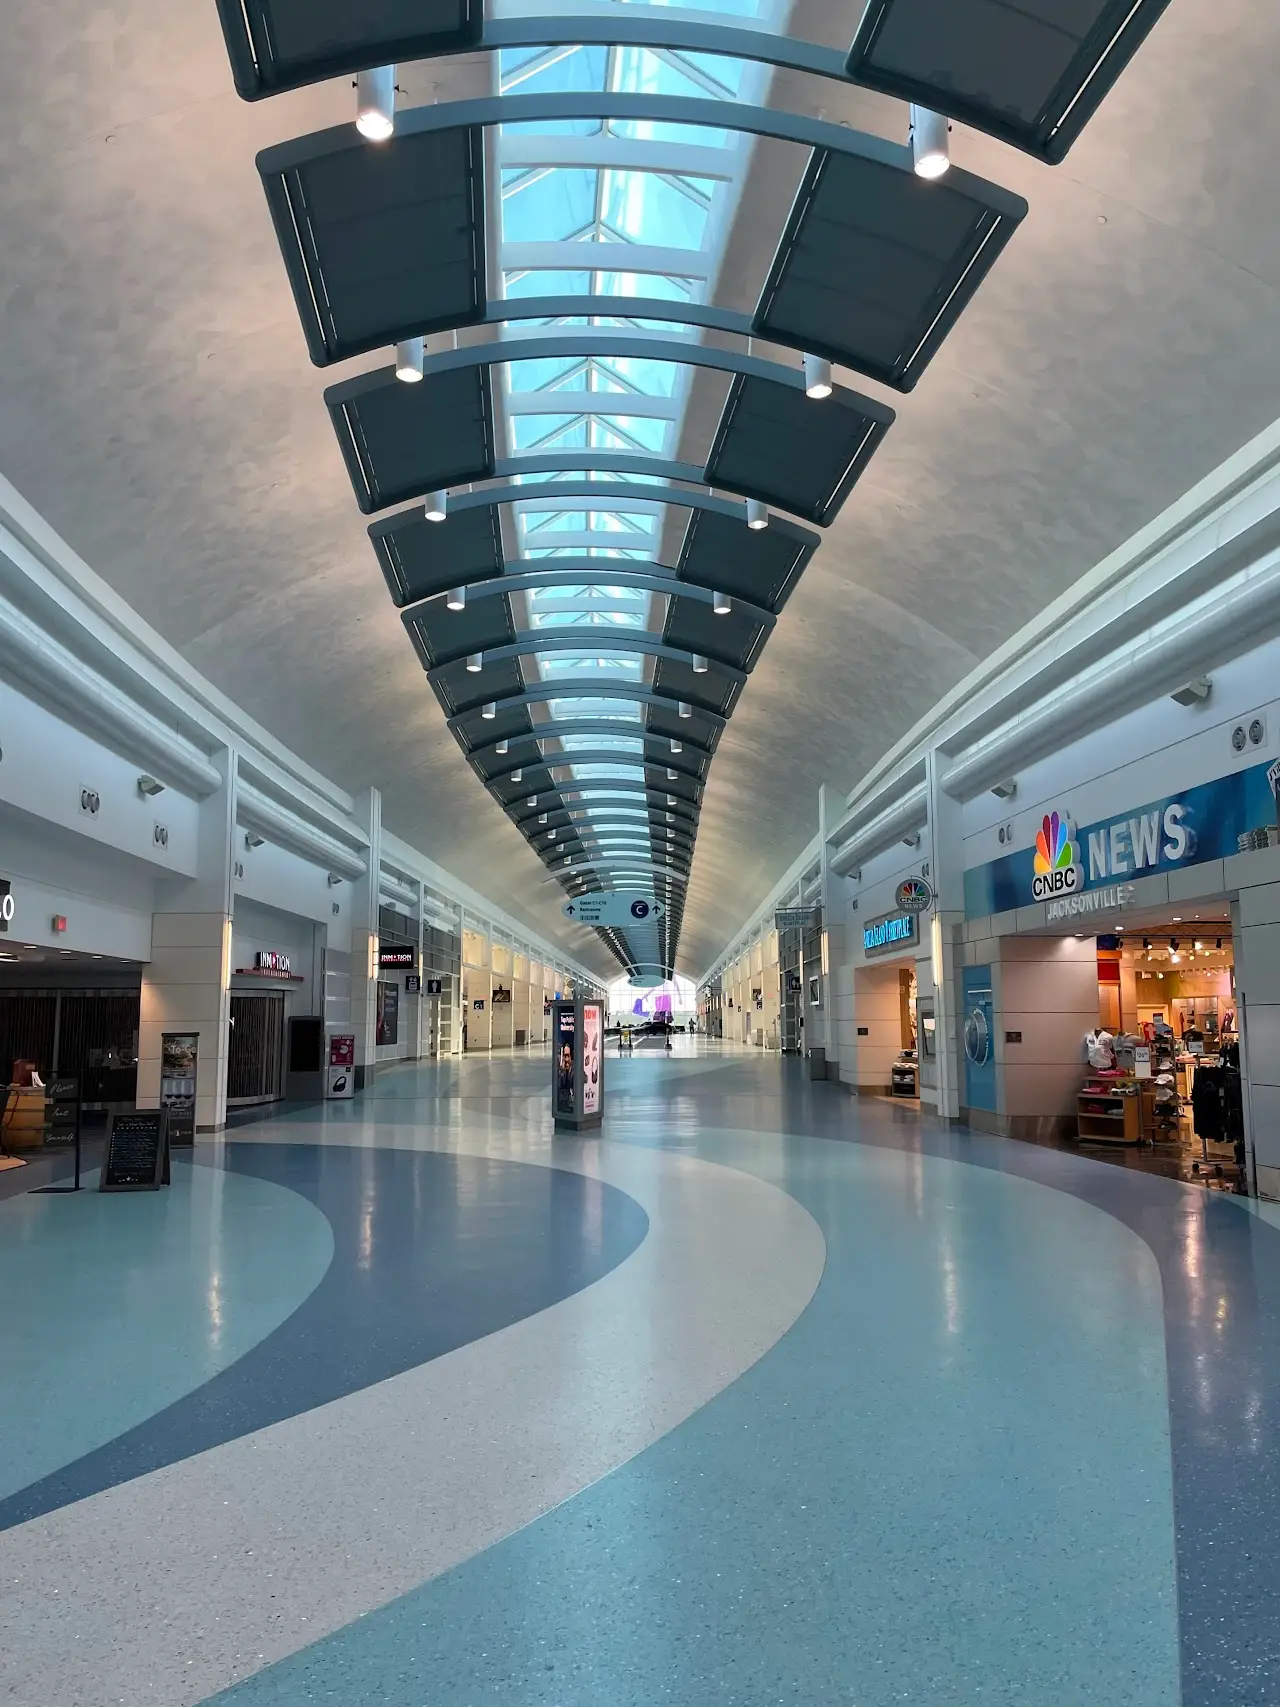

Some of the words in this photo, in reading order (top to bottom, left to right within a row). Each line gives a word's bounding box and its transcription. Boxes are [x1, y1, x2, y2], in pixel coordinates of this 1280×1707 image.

[1088, 803, 1186, 881] NEWS
[1032, 867, 1076, 897] CNBC
[636, 905, 644, 914] C
[1047, 885, 1126, 920] JACKSONVILLE
[171, 1044, 197, 1054] To-Go
